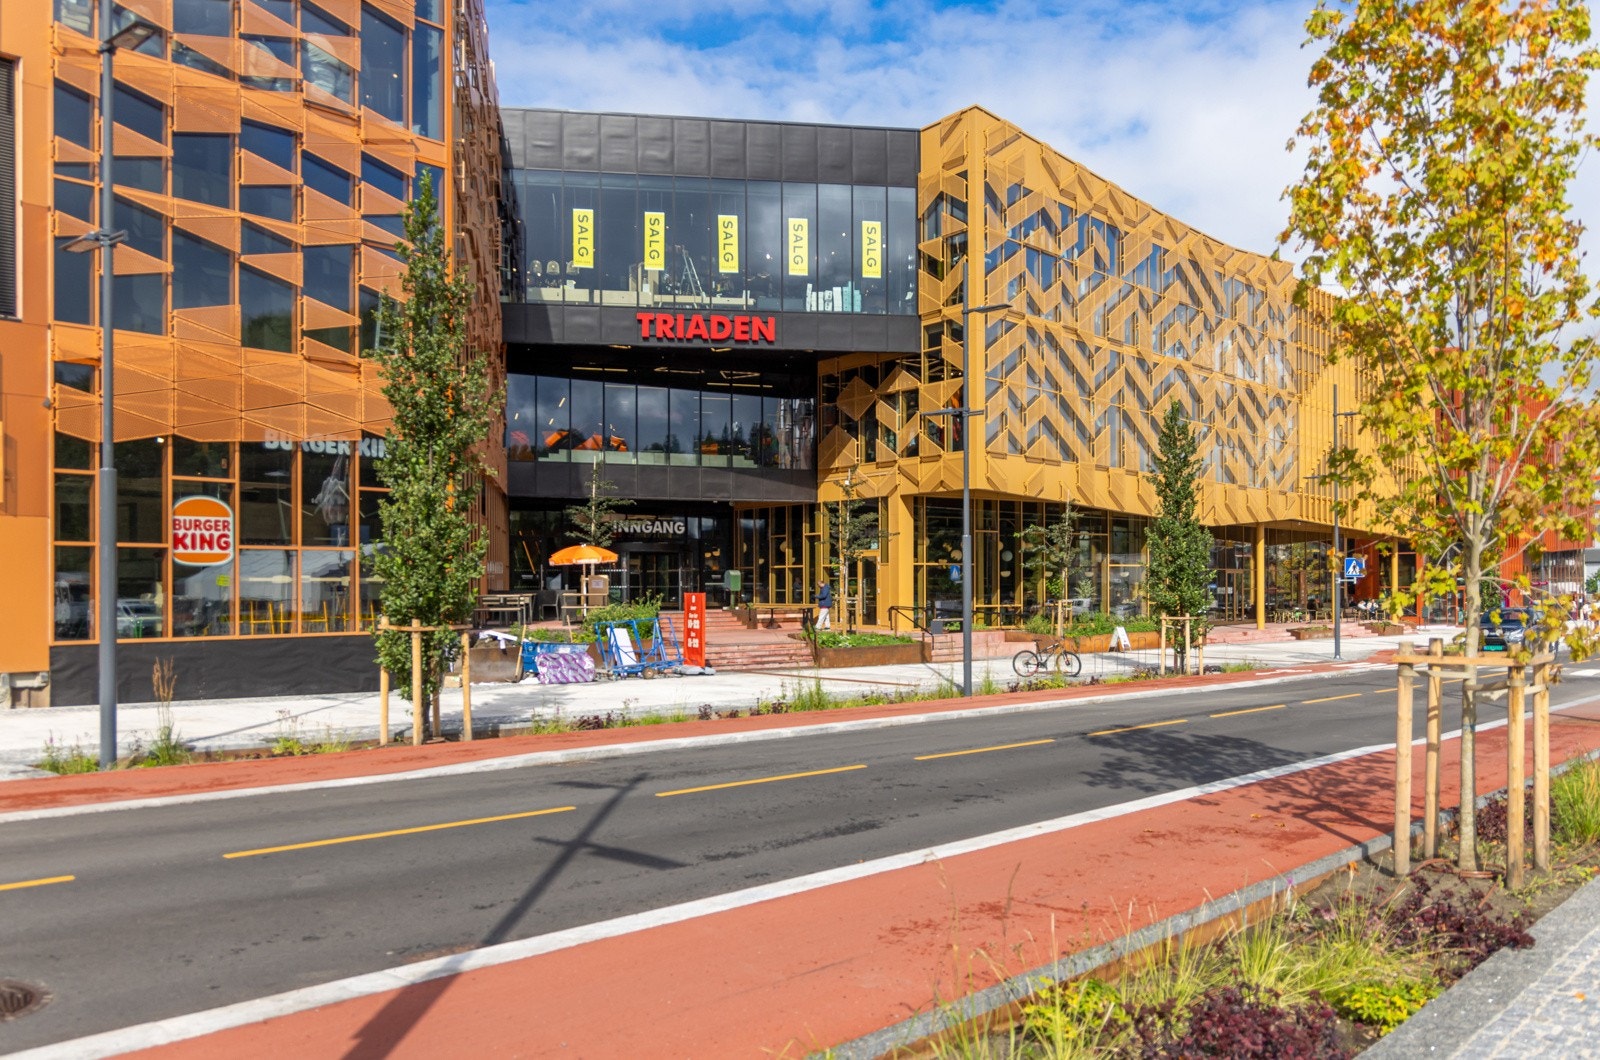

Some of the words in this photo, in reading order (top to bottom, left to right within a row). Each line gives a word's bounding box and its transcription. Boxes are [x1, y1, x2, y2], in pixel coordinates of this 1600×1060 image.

[577, 214, 589, 257] SALG
[649, 217, 661, 261] SALG
[722, 220, 734, 263] SALG
[793, 223, 804, 266] SALG
[866, 226, 877, 269] SALG
[637, 312, 776, 342] TRIADEN
[357, 437, 387, 458] KIN
[173, 518, 231, 532] BURGER
[173, 532, 231, 551] KING
